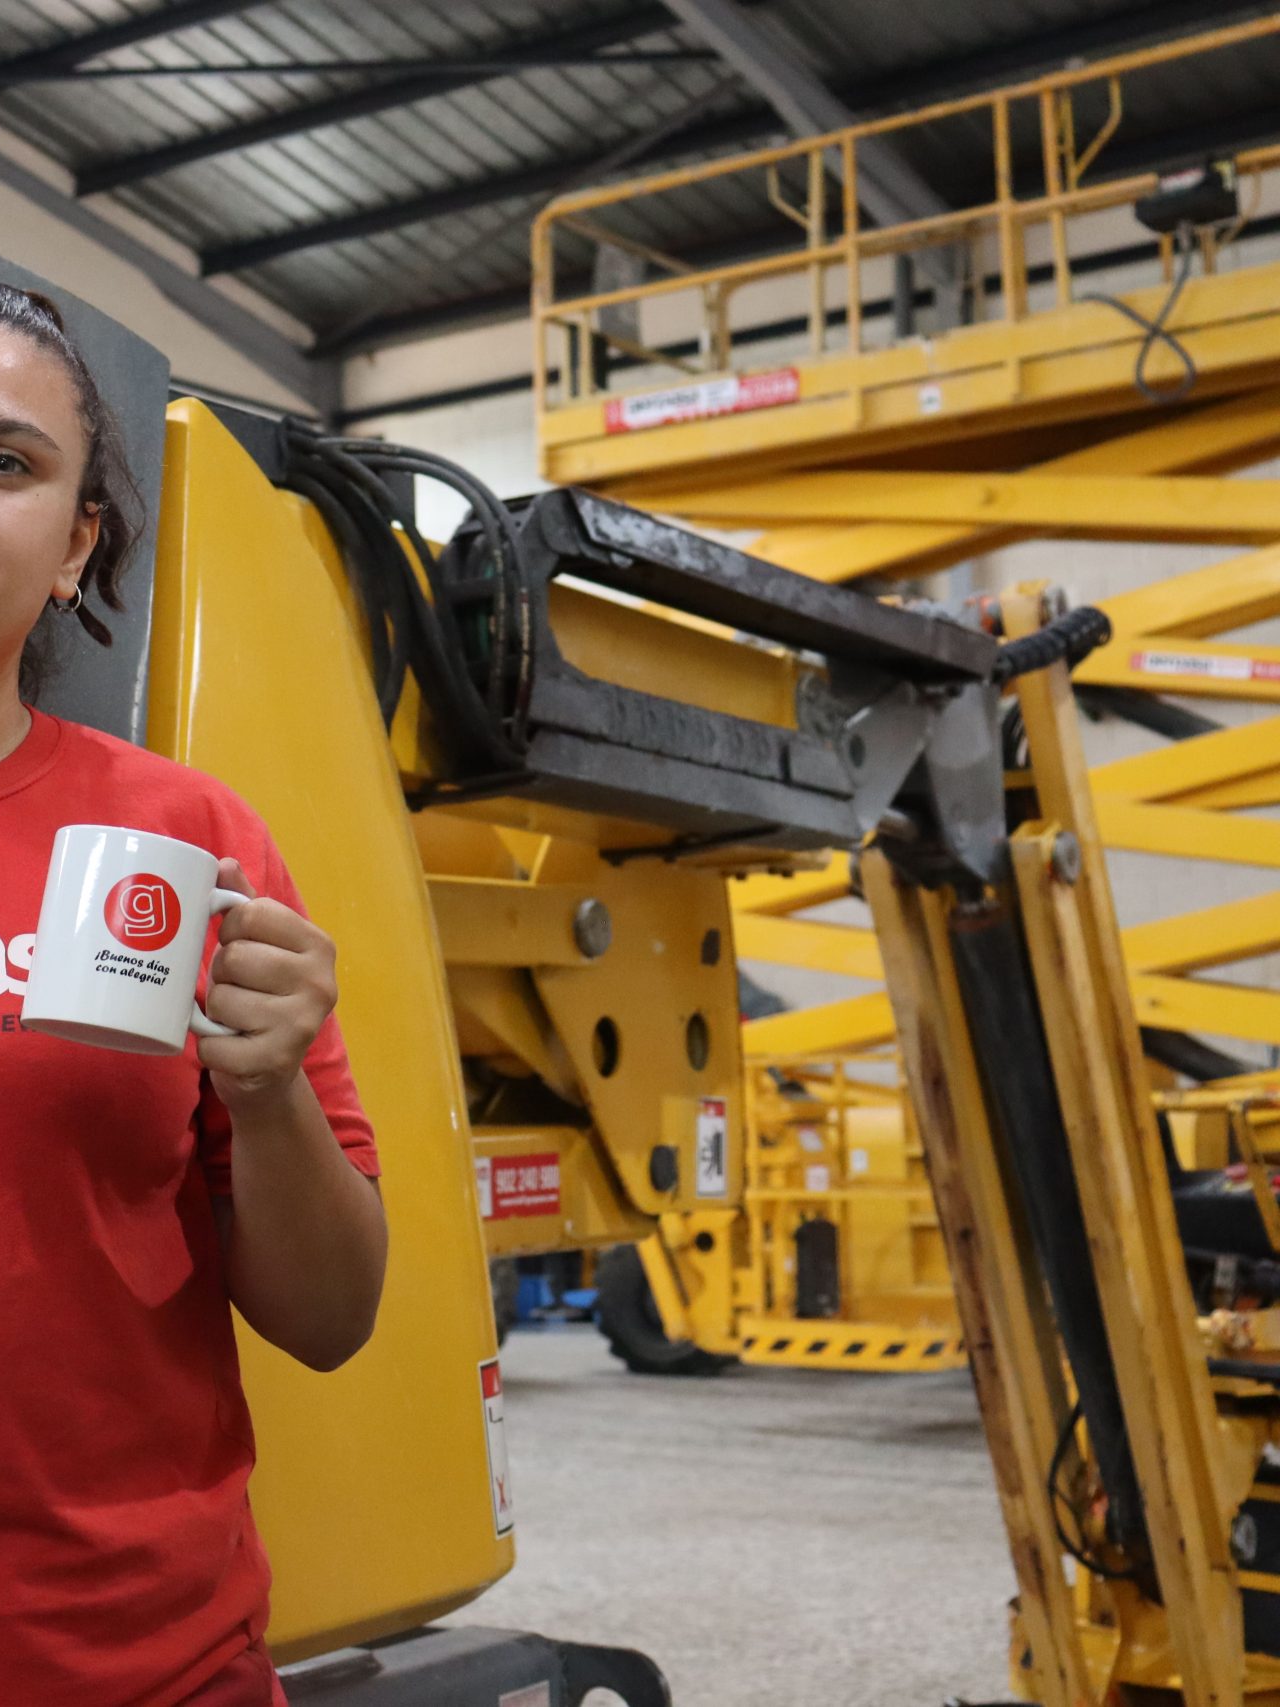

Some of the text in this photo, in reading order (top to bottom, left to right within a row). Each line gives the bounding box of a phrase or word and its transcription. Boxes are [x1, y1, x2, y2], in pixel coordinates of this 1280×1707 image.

[120, 884, 167, 937] g
[95, 949, 170, 975] ¡Buenos días
[95, 963, 166, 986] con alegría!
